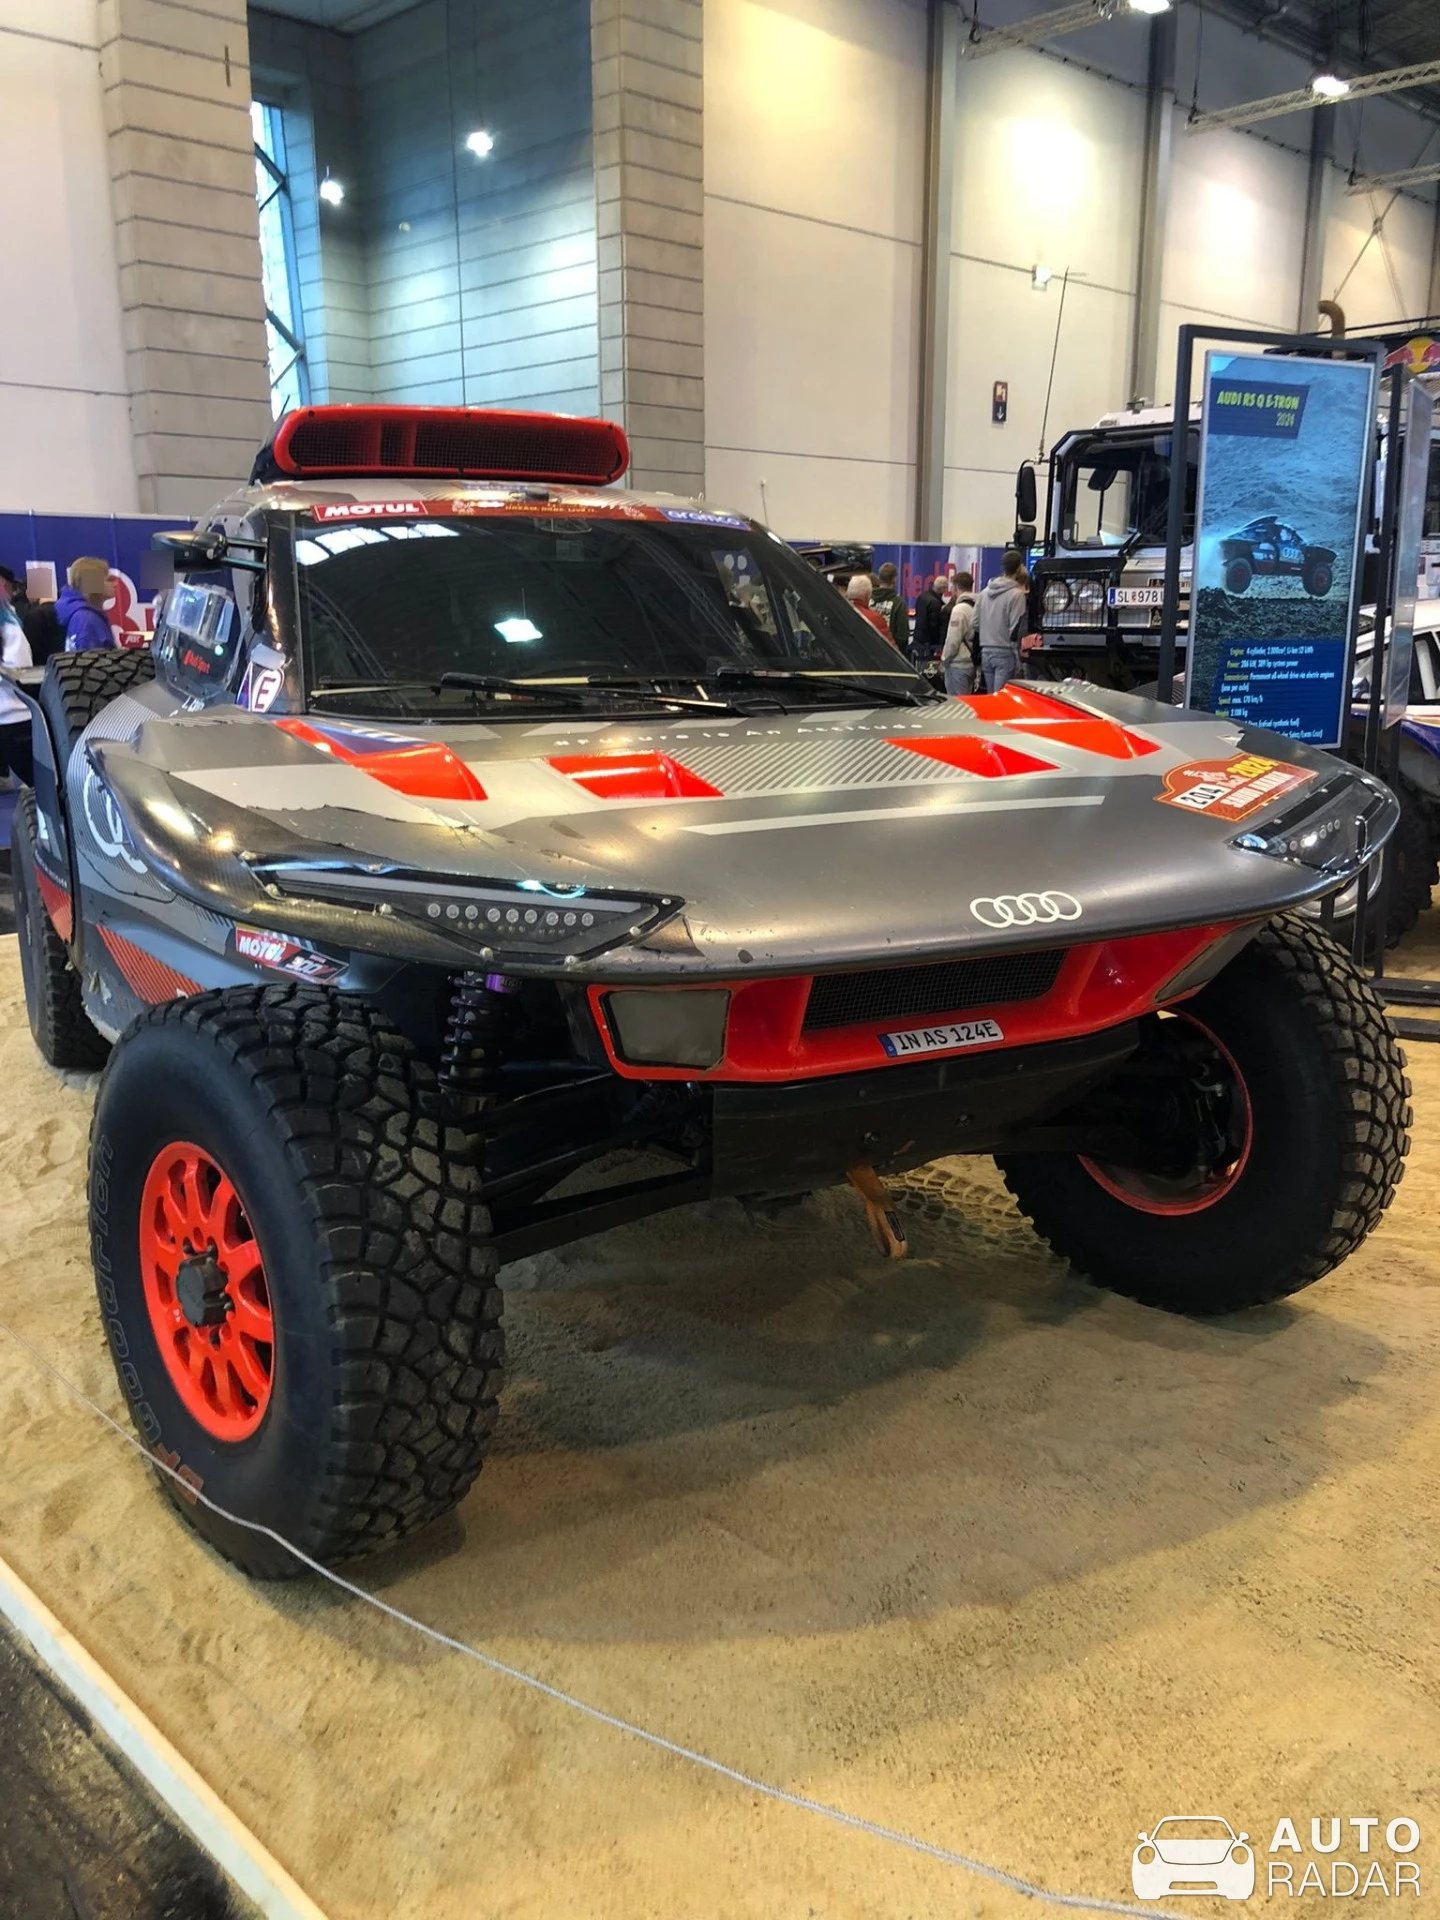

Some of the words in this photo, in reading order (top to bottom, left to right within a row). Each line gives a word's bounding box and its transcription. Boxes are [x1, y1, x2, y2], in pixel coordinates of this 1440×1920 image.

[1217, 391, 1242, 406] AUDI
[1243, 392, 1256, 407] RS
[1256, 394, 1265, 408] Q
[1265, 394, 1300, 410] E-TRON
[1276, 412, 1295, 427] 2024
[324, 502, 419, 518] MOTUL
[1117, 592, 1130, 603] SL
[1138, 590, 1158, 603] 978
[254, 676, 276, 710] E
[1180, 786, 1226, 806] 204
[239, 935, 287, 963] MOTUL
[896, 1033, 921, 1050] IN
[923, 1029, 948, 1046] AS
[950, 1021, 999, 1043] 124E
